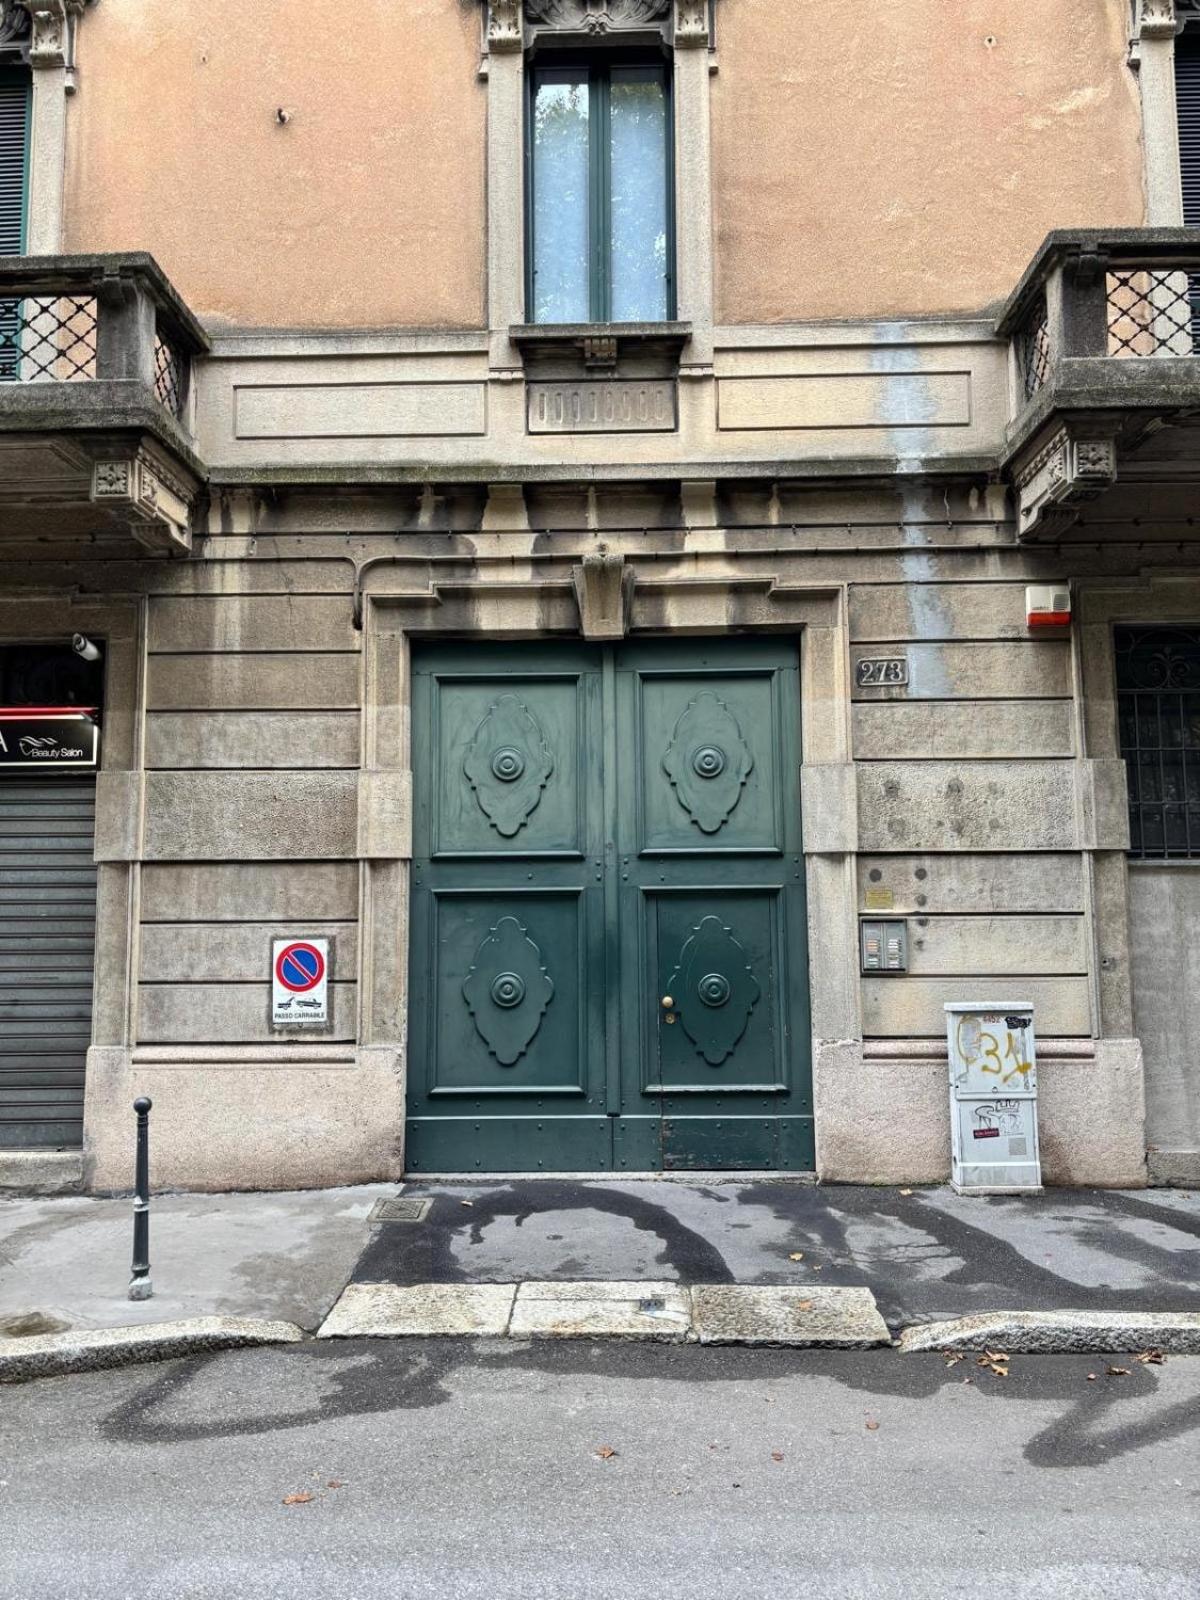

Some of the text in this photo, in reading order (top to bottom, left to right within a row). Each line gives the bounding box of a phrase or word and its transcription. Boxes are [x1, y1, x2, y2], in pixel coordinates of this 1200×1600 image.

[861, 661, 903, 683] 273
[31, 747, 83, 758] Beauty Salon
[294, 1011, 325, 1019] CARRABILE
